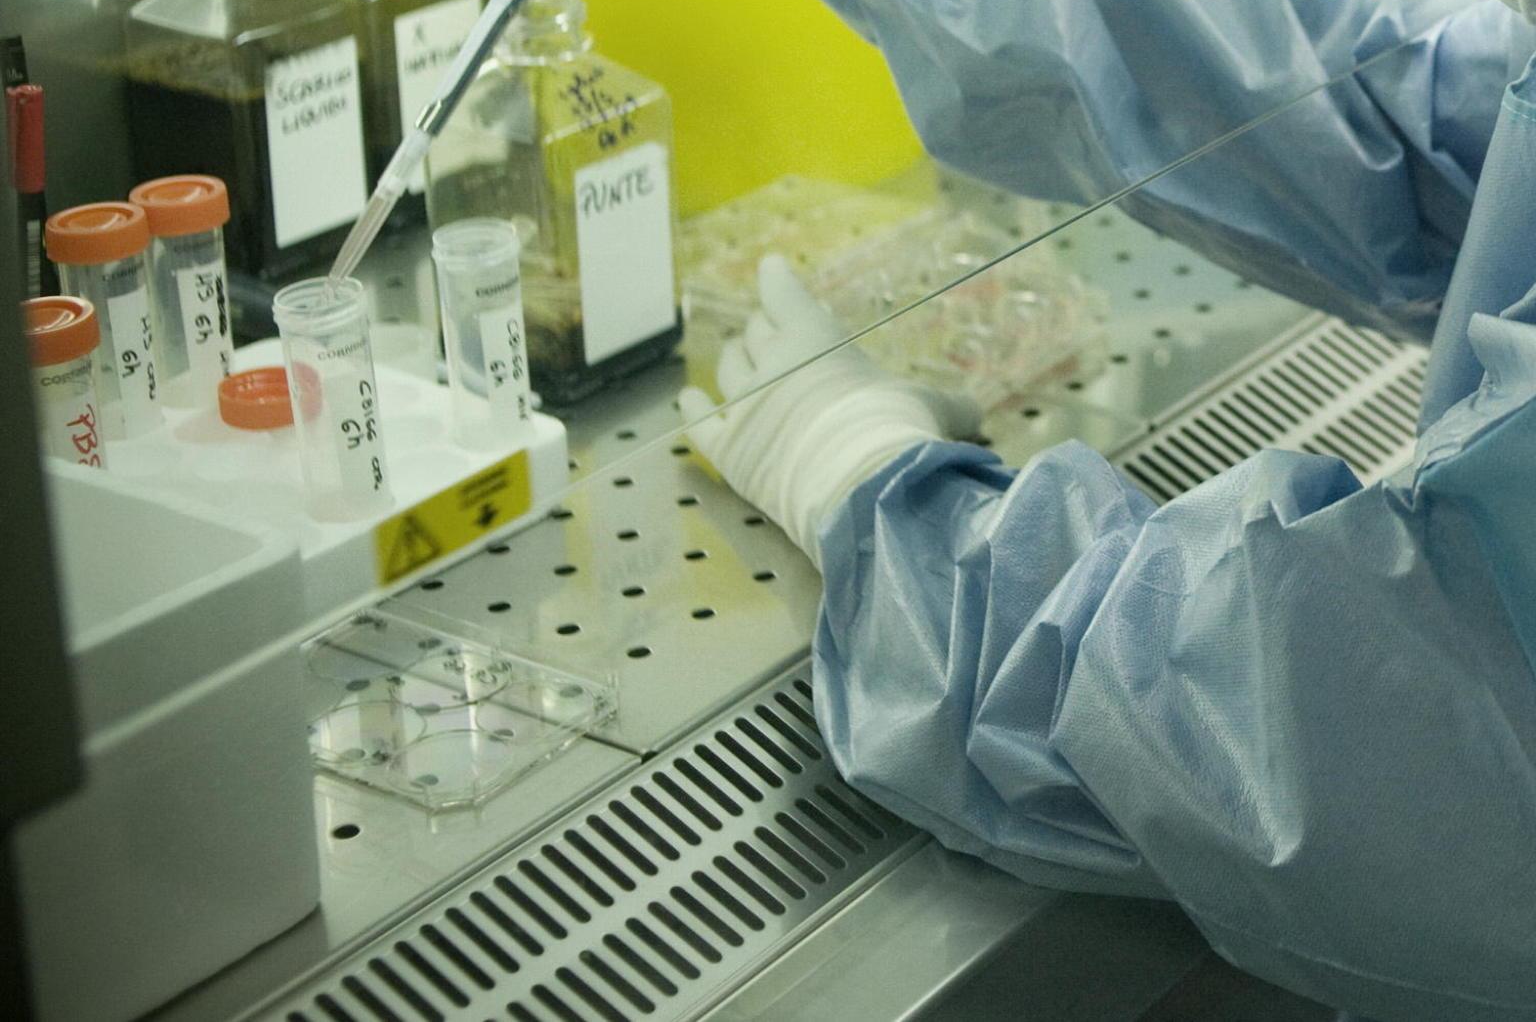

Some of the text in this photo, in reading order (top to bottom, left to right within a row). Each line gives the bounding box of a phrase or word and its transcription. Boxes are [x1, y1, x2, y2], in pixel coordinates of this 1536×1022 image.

[579, 166, 655, 218] PUNTE
[121, 349, 142, 379] 6h
[340, 418, 364, 451] 6h
